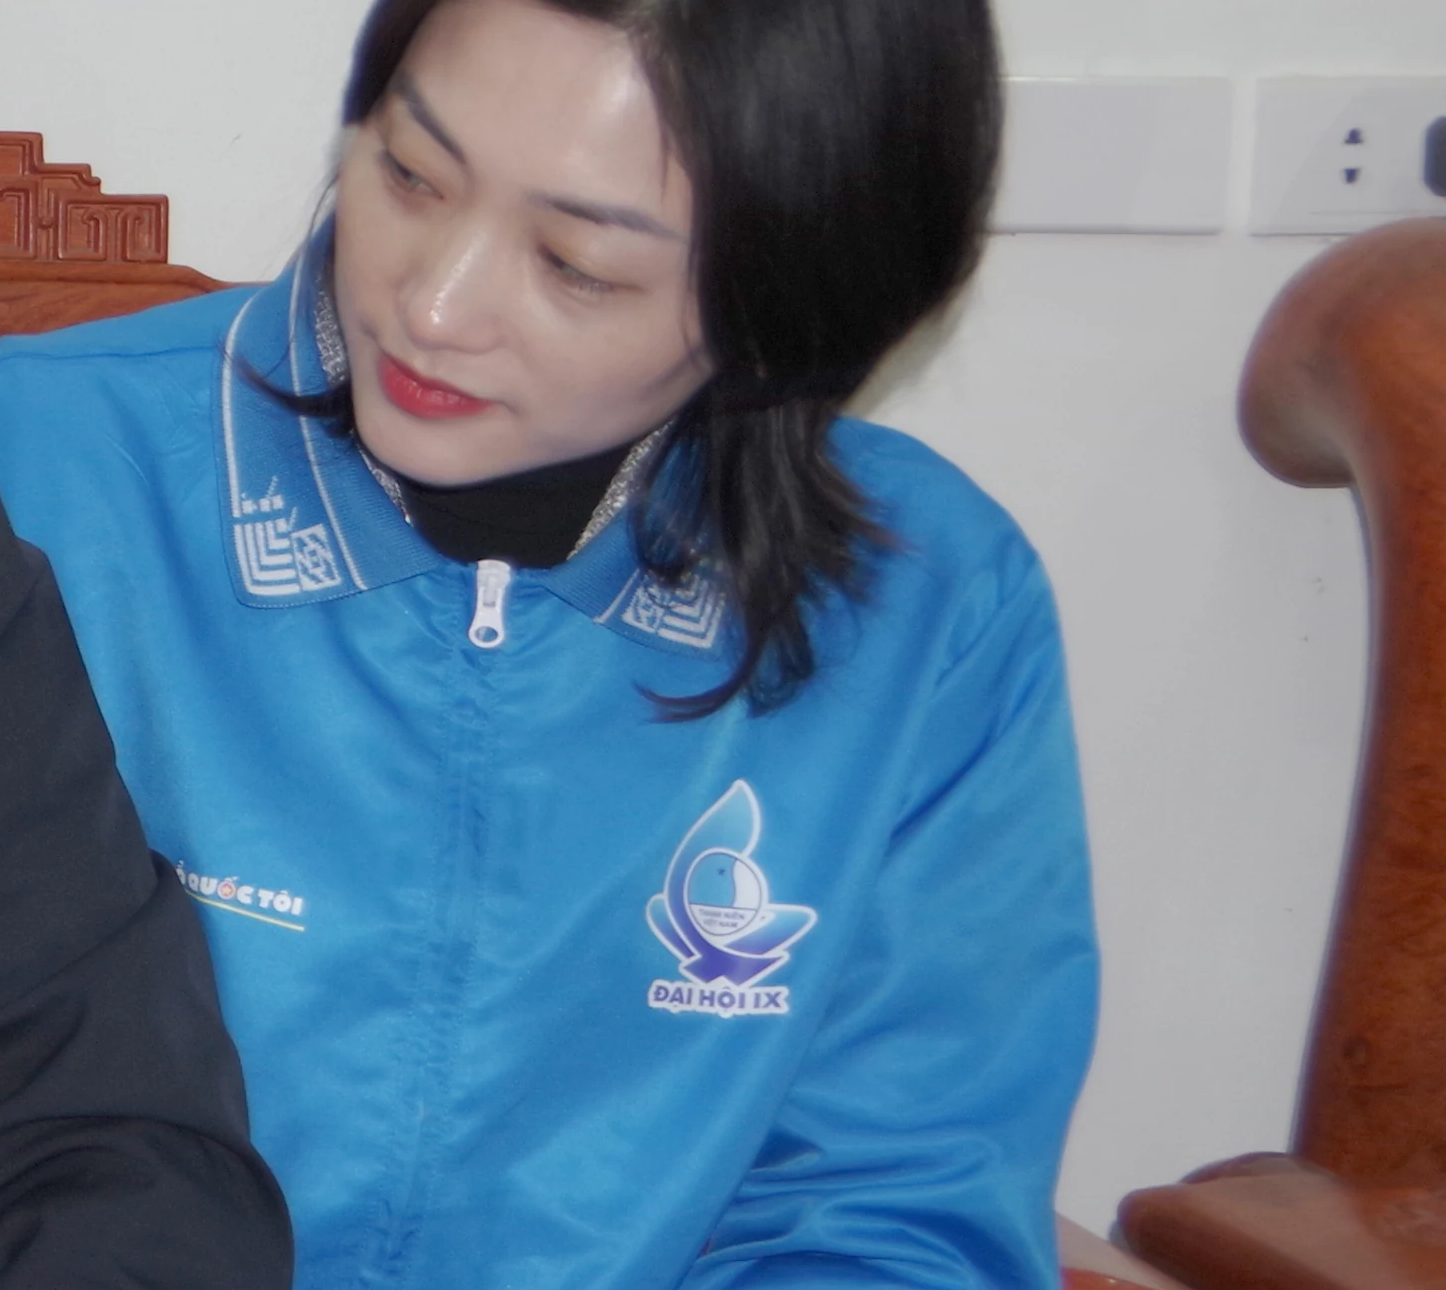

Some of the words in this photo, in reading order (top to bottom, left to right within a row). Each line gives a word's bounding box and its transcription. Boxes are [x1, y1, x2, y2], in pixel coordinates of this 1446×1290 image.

[188, 873, 255, 905] QUỐC
[258, 889, 303, 916] TÔI
[653, 984, 693, 1008] ĐẠI
[698, 986, 746, 1012] HỘI
[753, 991, 781, 1009] IX
